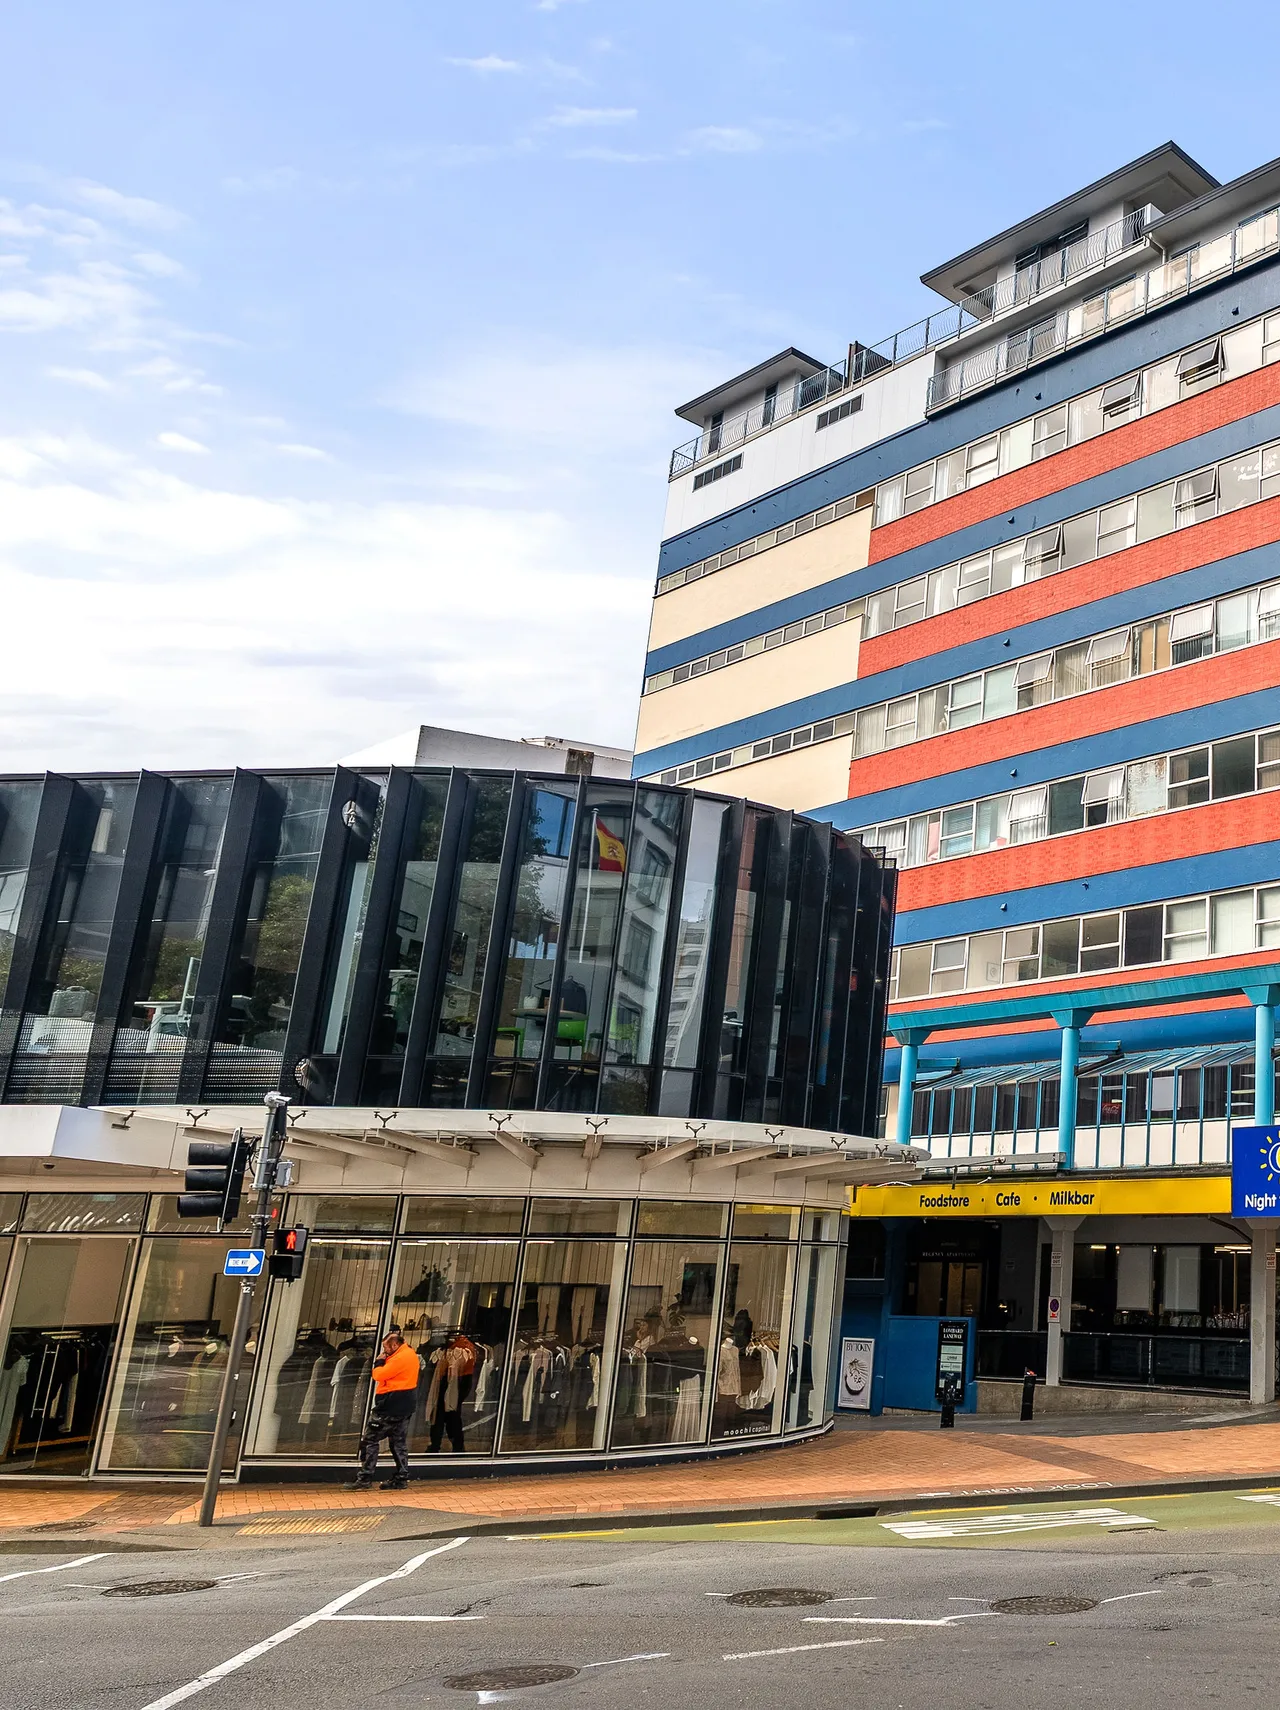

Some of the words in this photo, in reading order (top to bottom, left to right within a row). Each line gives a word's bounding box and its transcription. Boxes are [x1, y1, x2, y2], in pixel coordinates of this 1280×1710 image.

[919, 1194, 969, 1208] Foodstore
[996, 1192, 1020, 1207] Cafe
[1049, 1190, 1095, 1206] Milkbar
[1244, 1193, 1277, 1211] Night
[1046, 1481, 1113, 1490] LOOK
